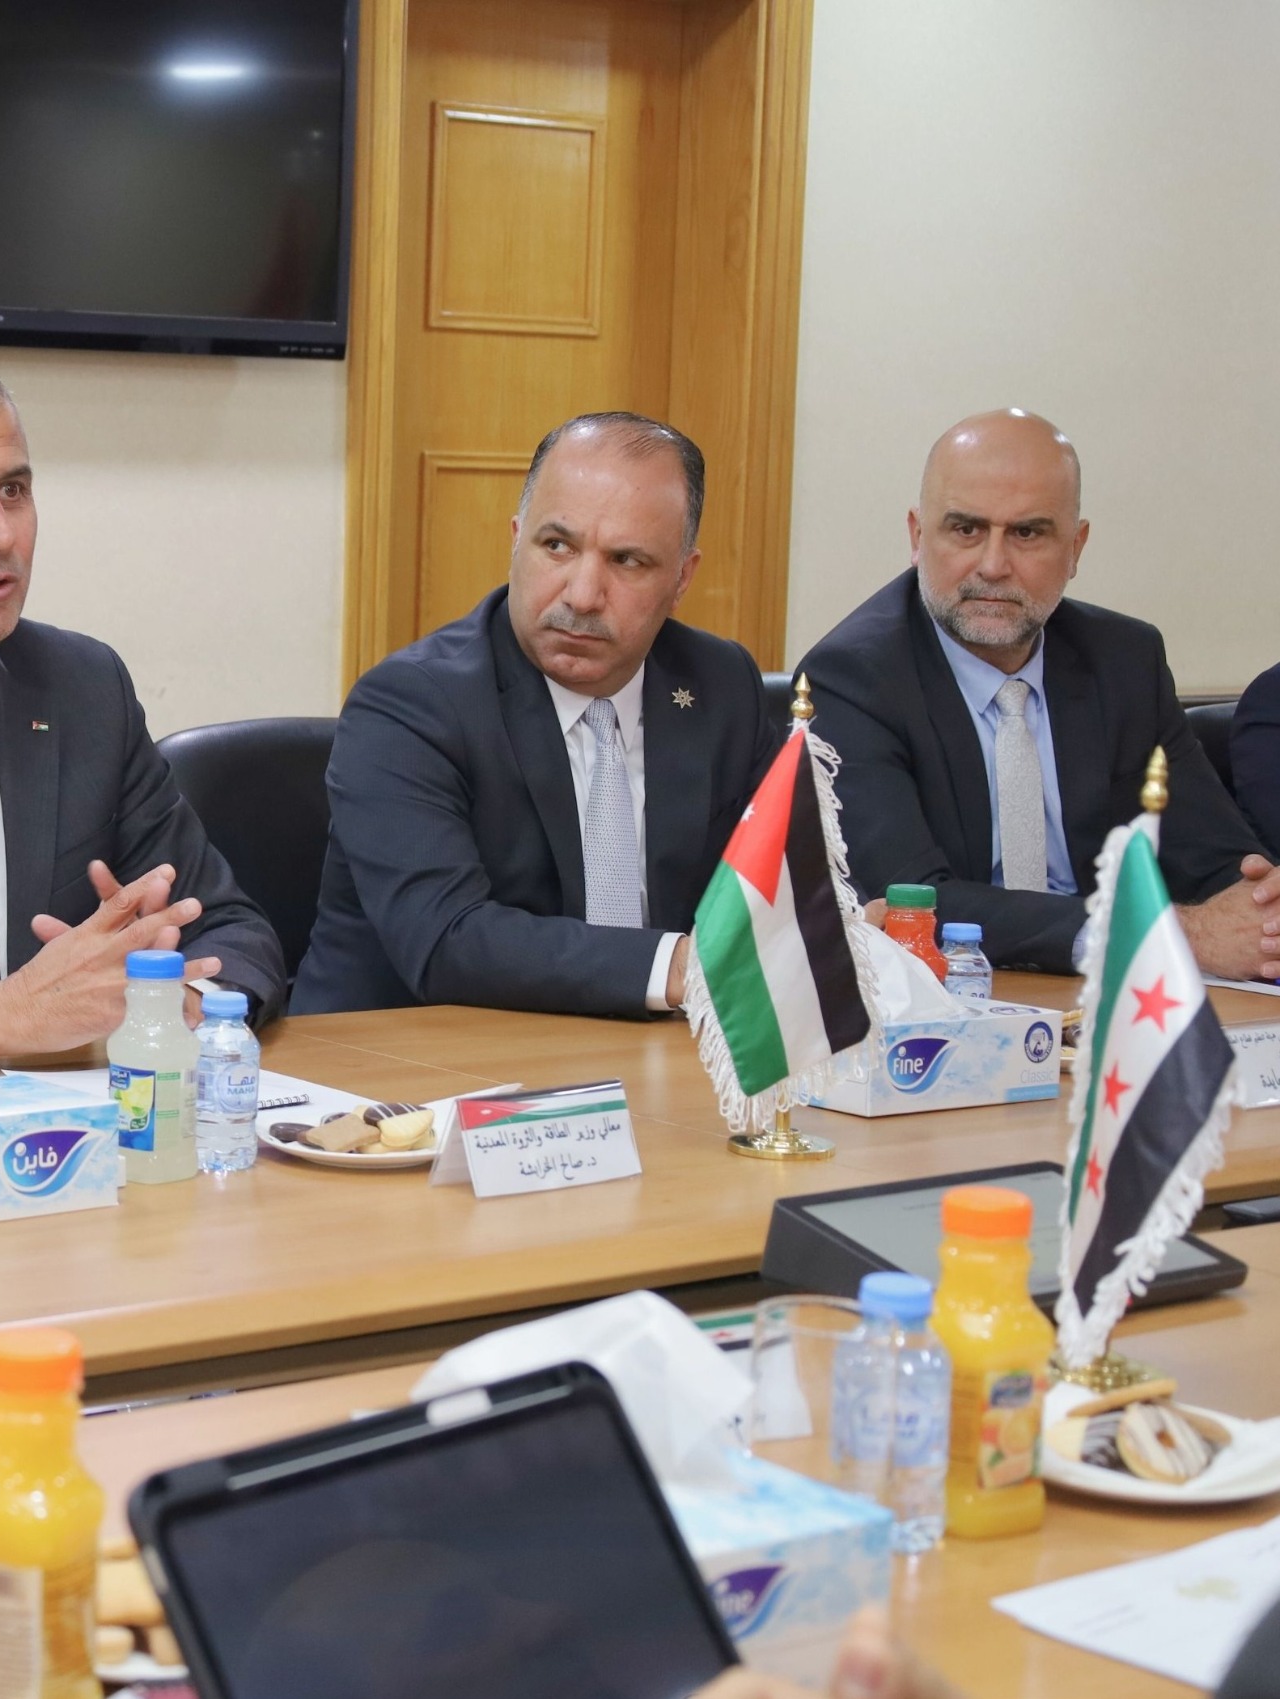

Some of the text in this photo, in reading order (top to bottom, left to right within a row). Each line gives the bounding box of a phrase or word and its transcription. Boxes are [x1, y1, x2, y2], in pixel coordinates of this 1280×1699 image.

[475, 1115, 621, 1154] معالي وزير الطاقة والثروة المعدنية
[13, 1142, 59, 1176] فاين
[559, 1153, 583, 1180] صالح
